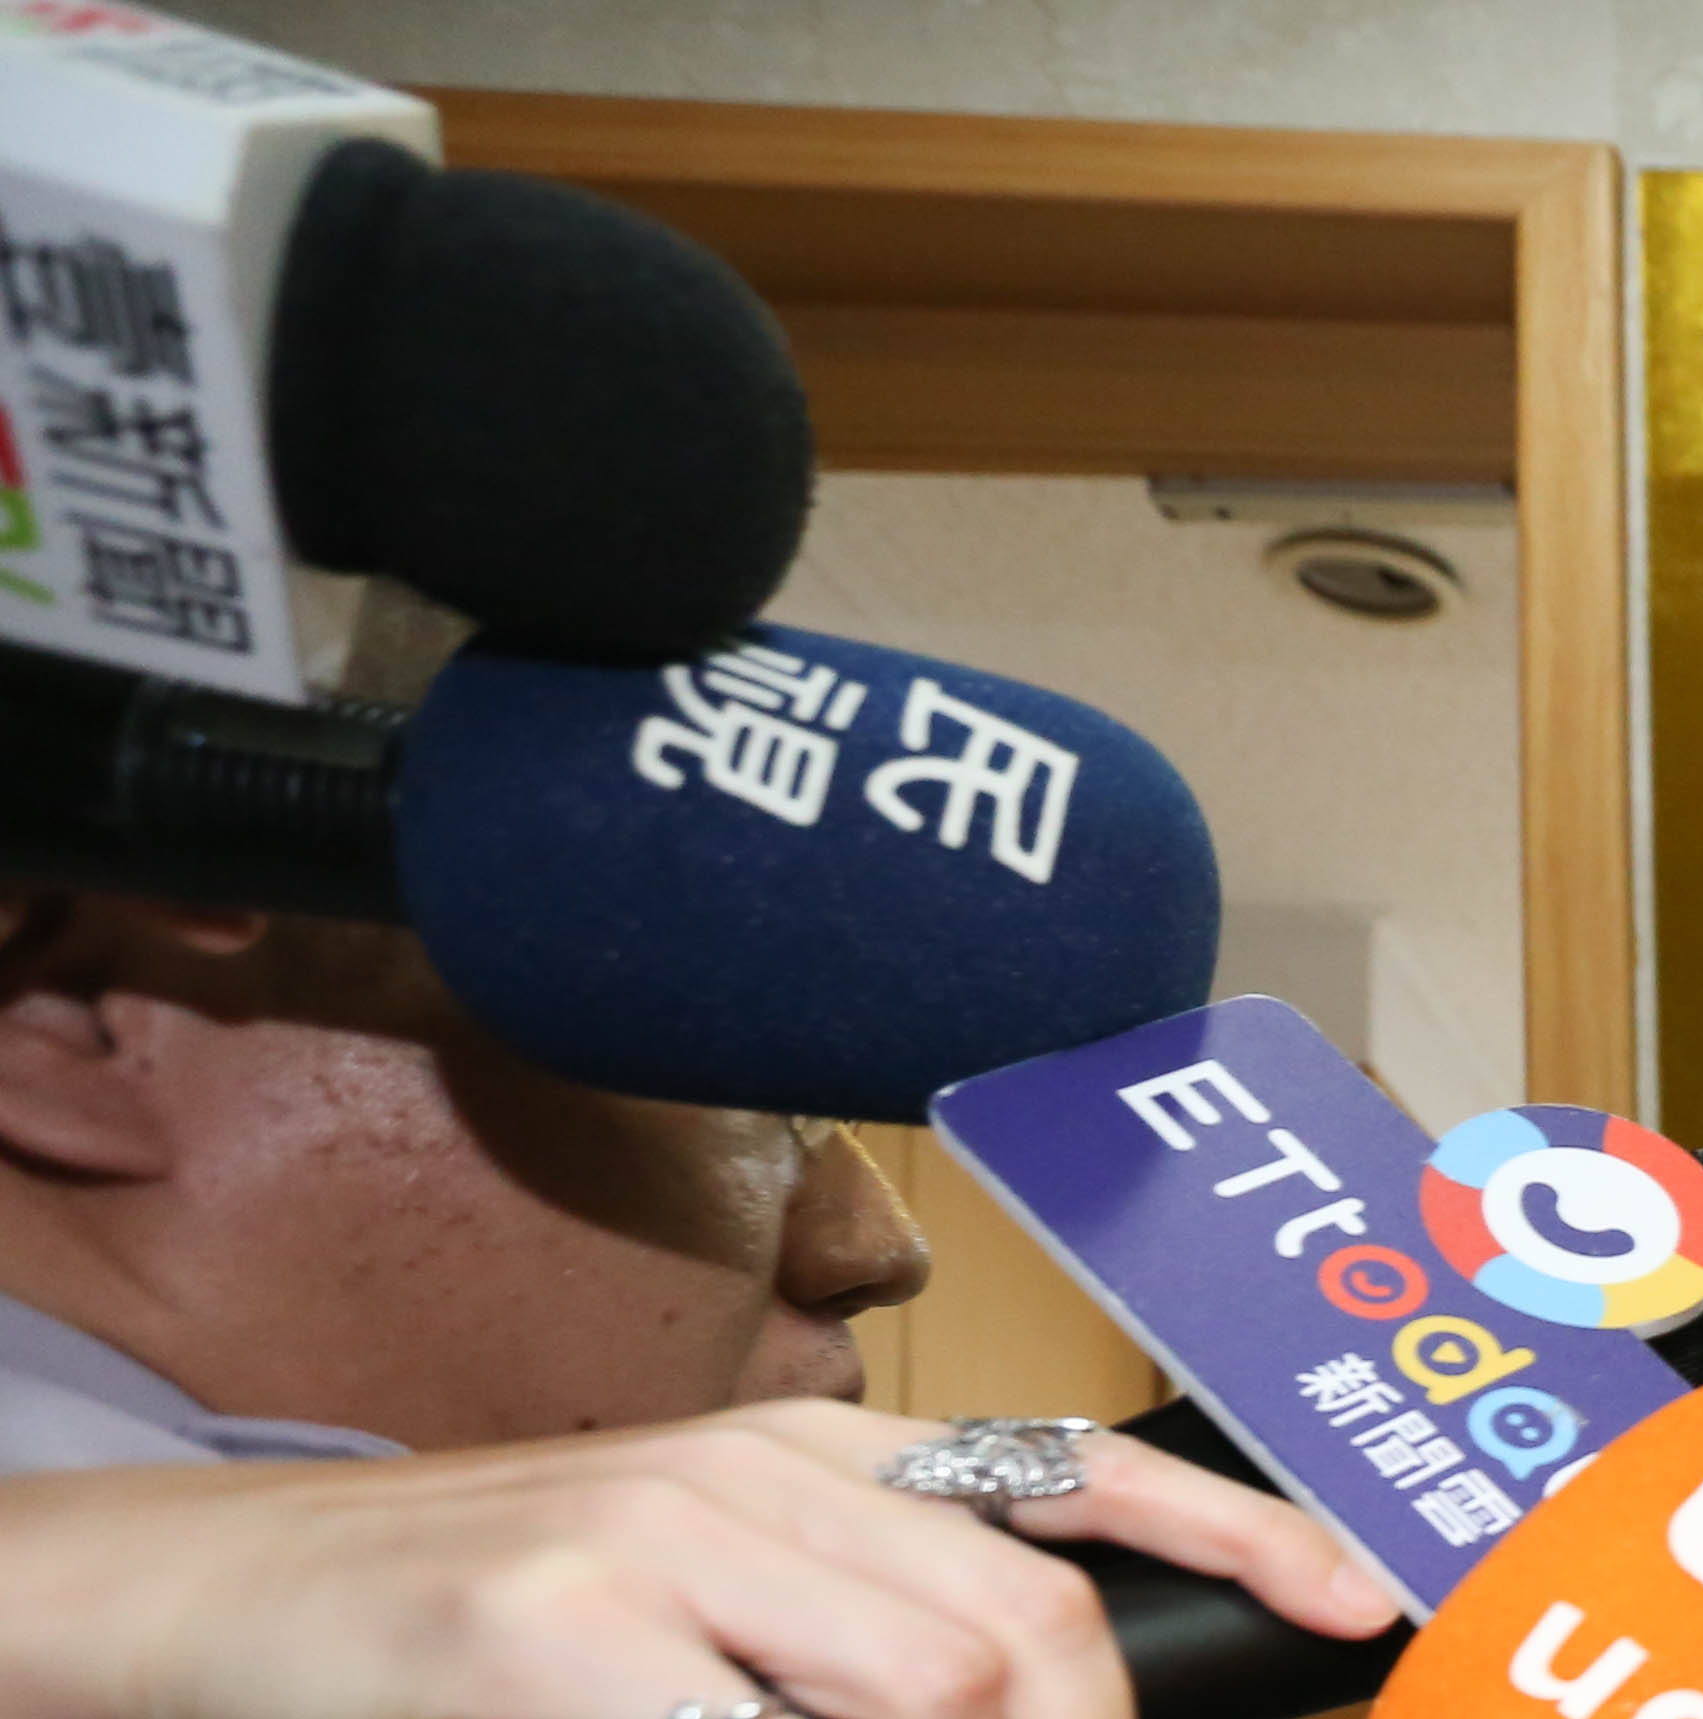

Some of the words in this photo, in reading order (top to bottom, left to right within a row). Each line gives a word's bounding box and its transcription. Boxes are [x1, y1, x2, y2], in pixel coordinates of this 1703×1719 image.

[632, 640, 1082, 886] 民視
[1116, 1058, 1600, 1500] ETtoda
[1295, 1352, 1525, 1548] 新聞雲
